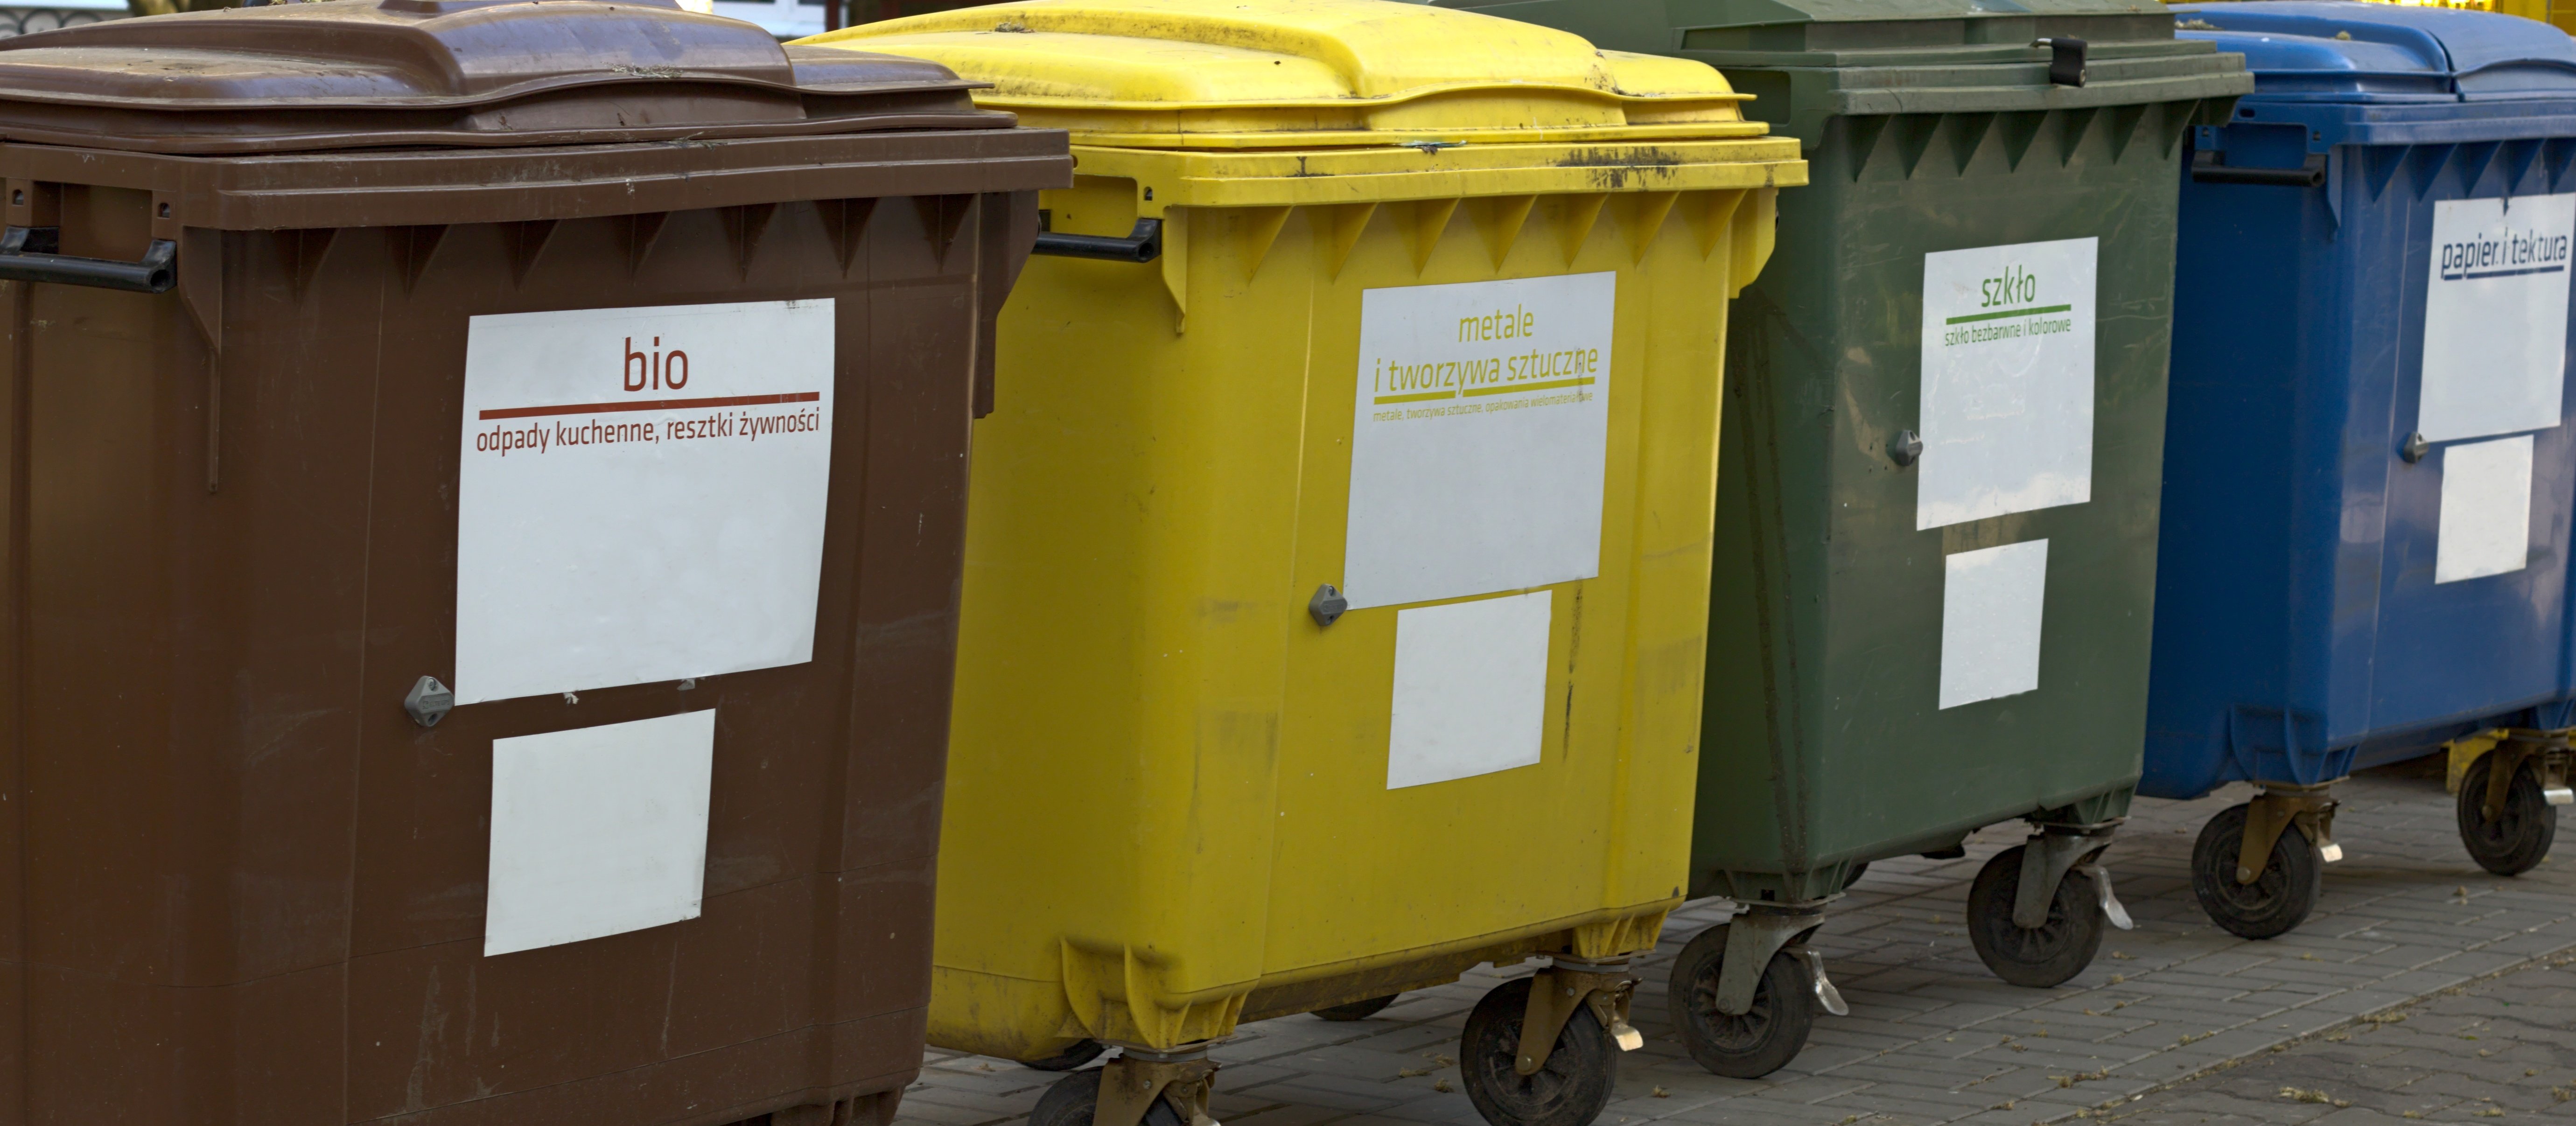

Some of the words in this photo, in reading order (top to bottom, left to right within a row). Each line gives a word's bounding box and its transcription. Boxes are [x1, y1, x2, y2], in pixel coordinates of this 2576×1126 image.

[2441, 232, 2499, 279] papier
[2502, 226, 2508, 265] i
[2512, 229, 2567, 265] tektura
[1981, 264, 2036, 308] szkło
[1458, 304, 1533, 342] metale
[1945, 326, 1969, 347] szkło
[1972, 322, 2021, 343] bezbarwne
[2023, 319, 2027, 336] i
[2029, 316, 2071, 336] kolorowe
[623, 336, 689, 392] bio
[1374, 357, 1381, 392] i
[1388, 357, 1501, 395] tworzywa
[1506, 347, 1598, 381] sztuczne
[1373, 409, 1404, 422] metale,
[1407, 407, 1445, 420] tworzywa
[1447, 403, 1484, 416] sztuczne,
[1485, 397, 1529, 413] opakowania
[1531, 392, 1593, 407] wielomateriałowe
[476, 422, 550, 457] odpady
[555, 419, 660, 446] kuchenne,
[666, 412, 733, 440] resztki
[738, 406, 820, 441] żywności
